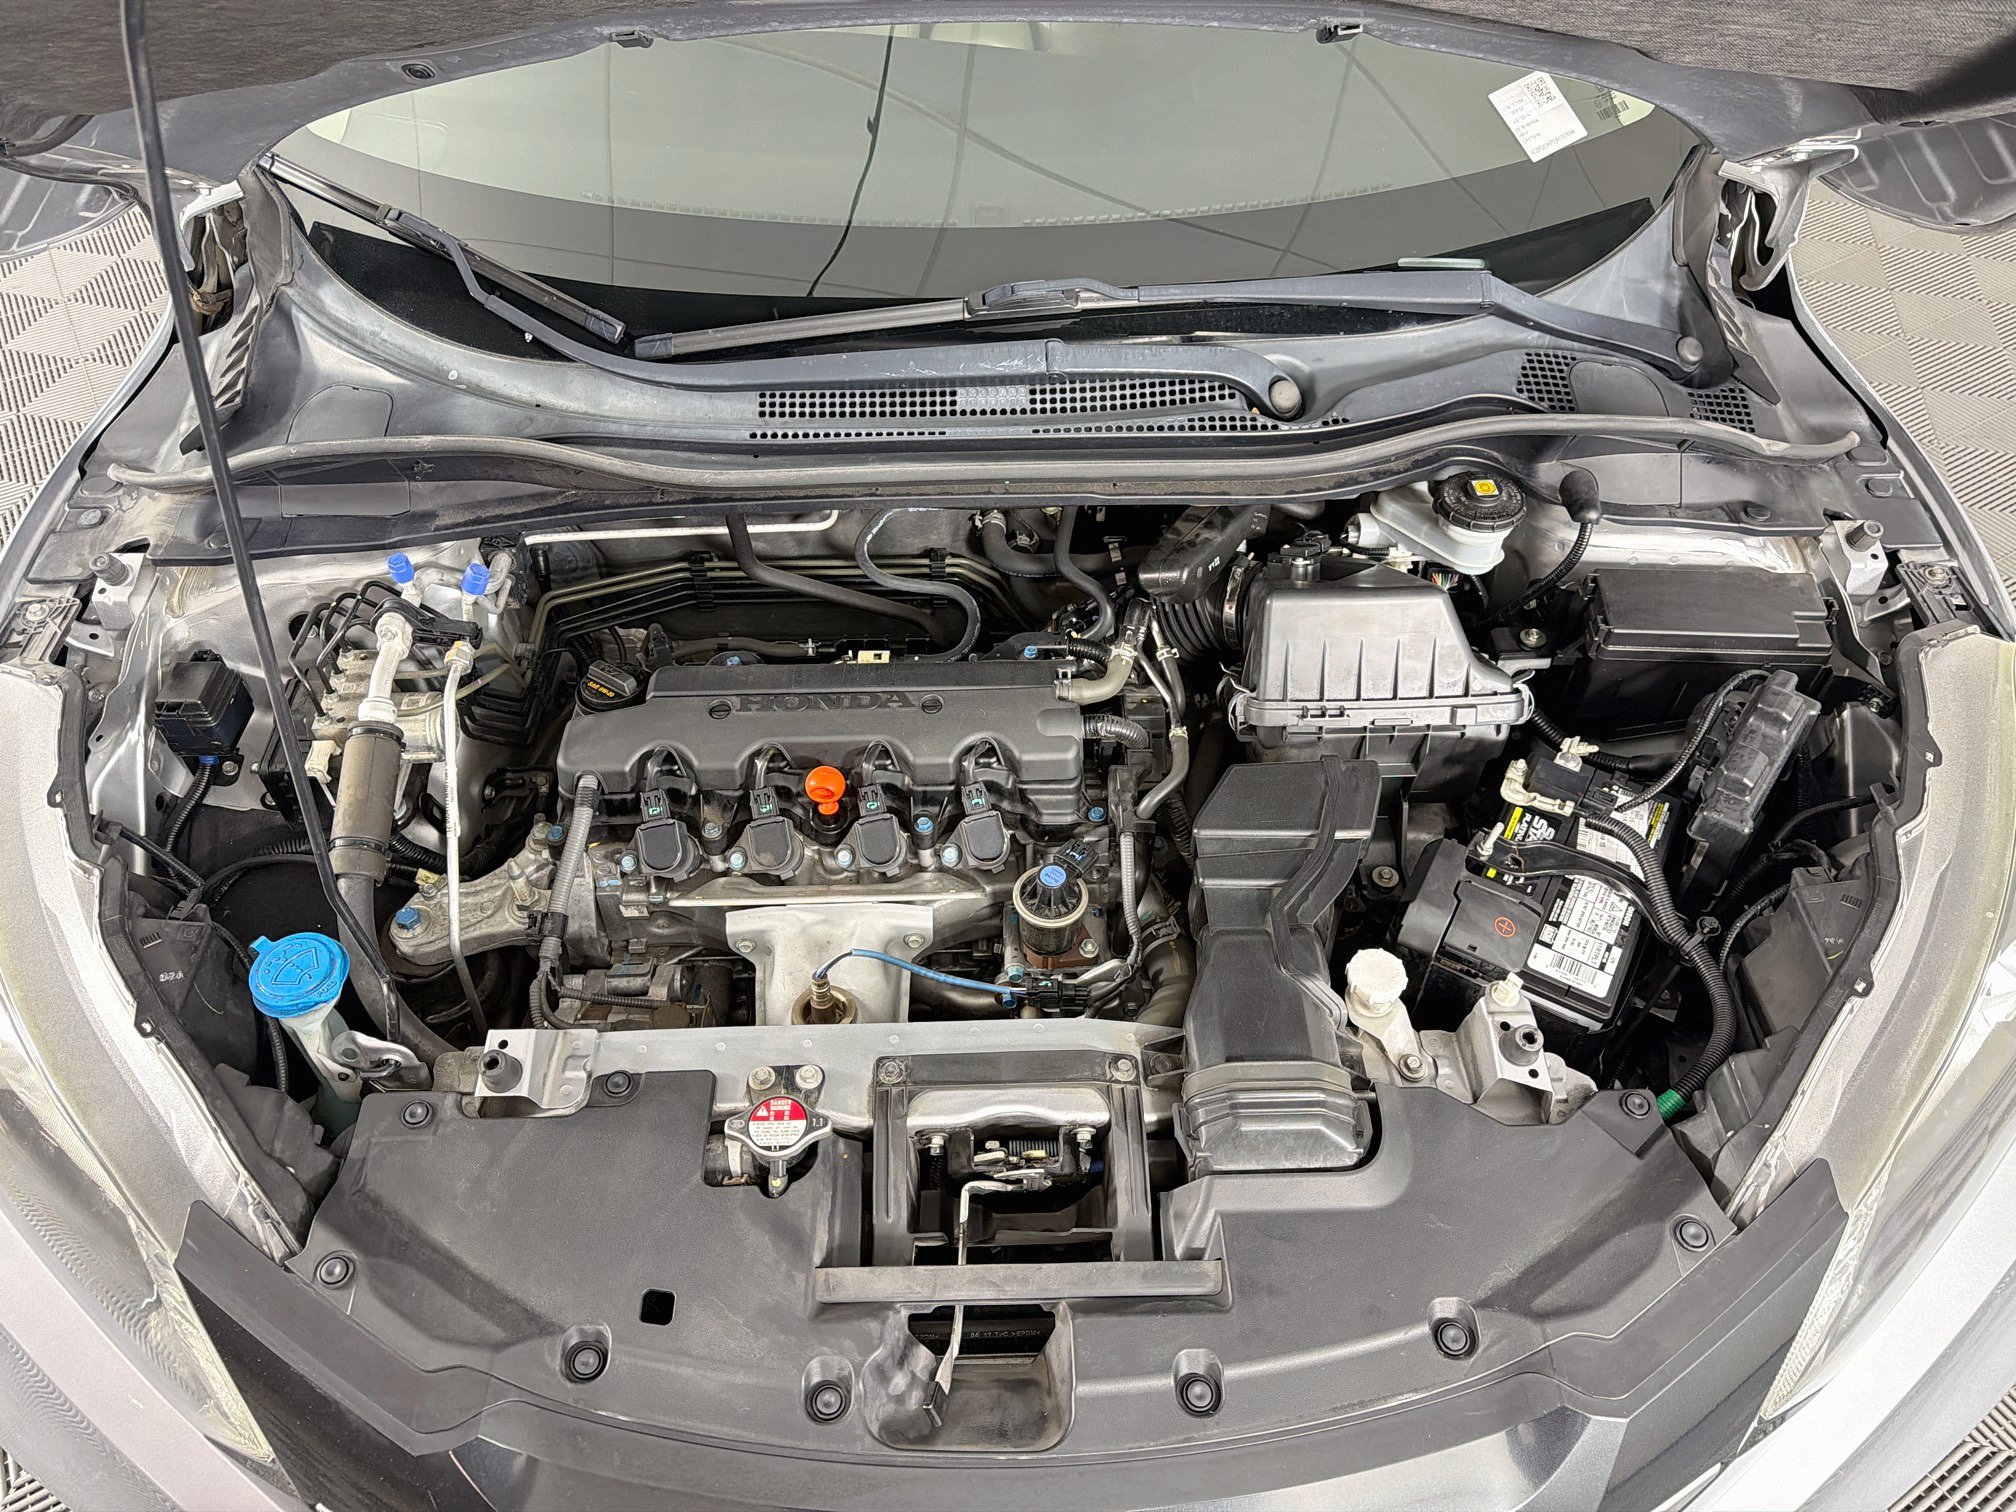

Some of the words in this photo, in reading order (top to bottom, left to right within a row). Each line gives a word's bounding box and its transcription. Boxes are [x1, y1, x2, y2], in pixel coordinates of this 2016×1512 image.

[734, 691, 916, 714] HONDA
[1524, 815, 1548, 841] STA
[1622, 906, 1635, 926] OISON
[812, 1118, 823, 1127] 1.1
